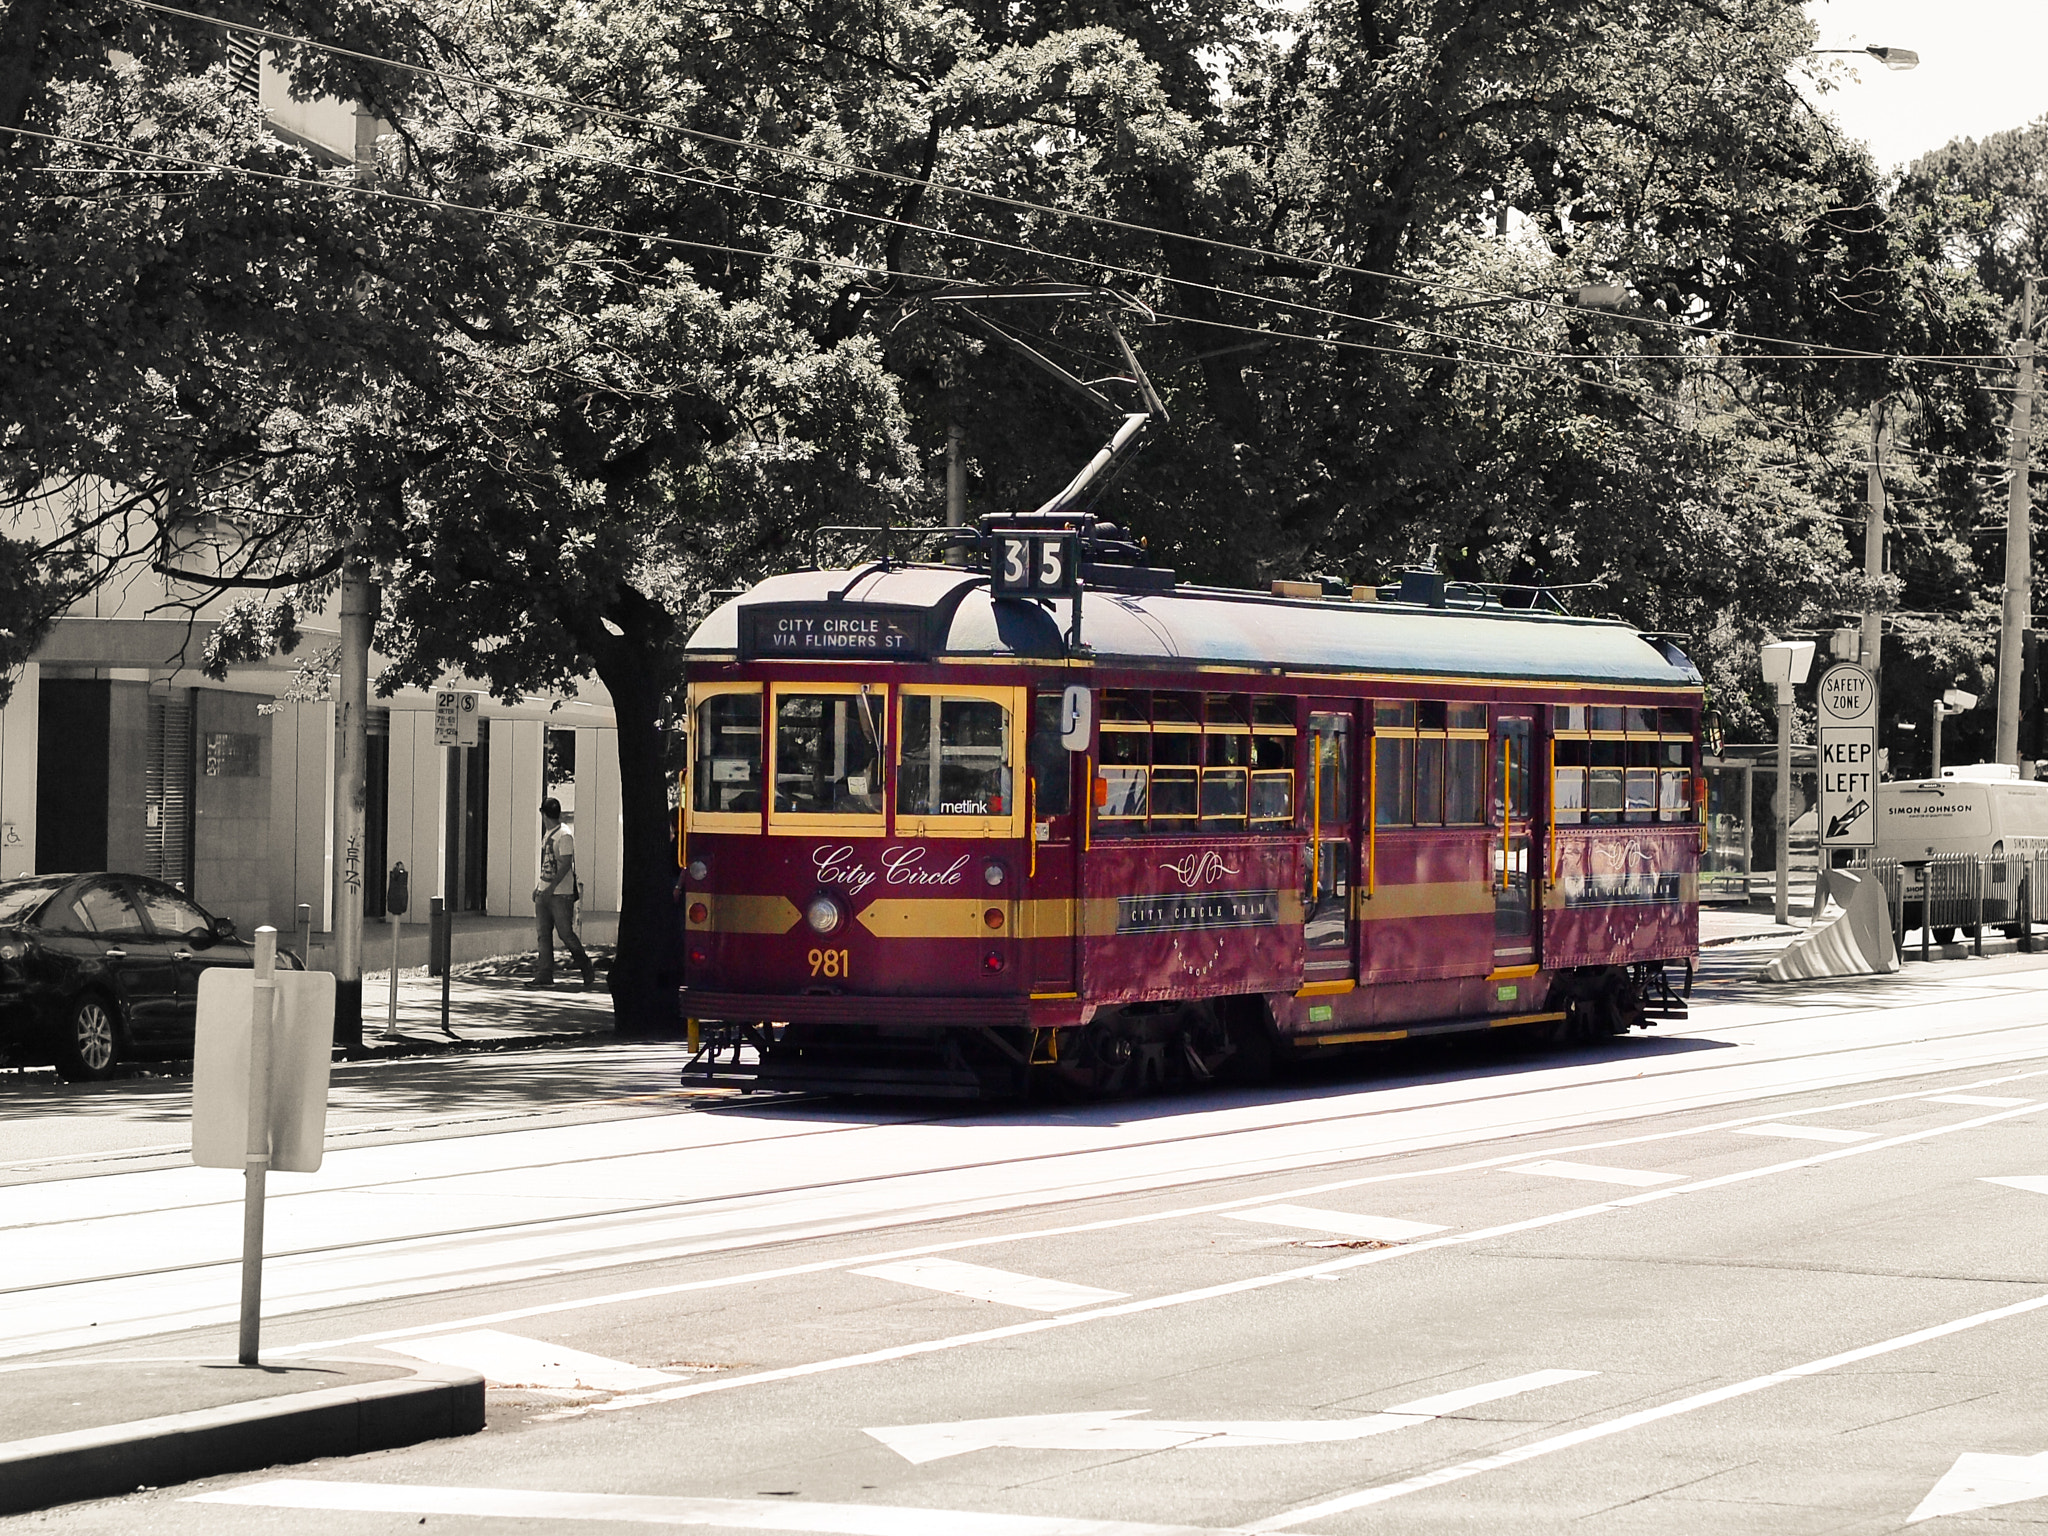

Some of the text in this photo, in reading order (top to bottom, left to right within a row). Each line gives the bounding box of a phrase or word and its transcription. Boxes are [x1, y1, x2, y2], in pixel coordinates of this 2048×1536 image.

[1004, 539, 1062, 585] 35
[778, 619, 814, 632] CITY
[823, 619, 879, 633] CIRCLE
[773, 634, 903, 648] VIA FLINDERS ST
[1826, 678, 1866, 692] SAFETY
[438, 693, 455, 707] 2P
[1833, 695, 1860, 709] ZONE
[1823, 743, 1872, 763] KEEP
[1825, 773, 1871, 793] LEFT
[940, 799, 988, 814] metlink
[1888, 804, 1973, 815] SIMON JOHNSON
[812, 845, 970, 895] City Circle
[1131, 903, 1265, 922] CITY CIRCLE TRAM
[808, 948, 849, 978] 981
